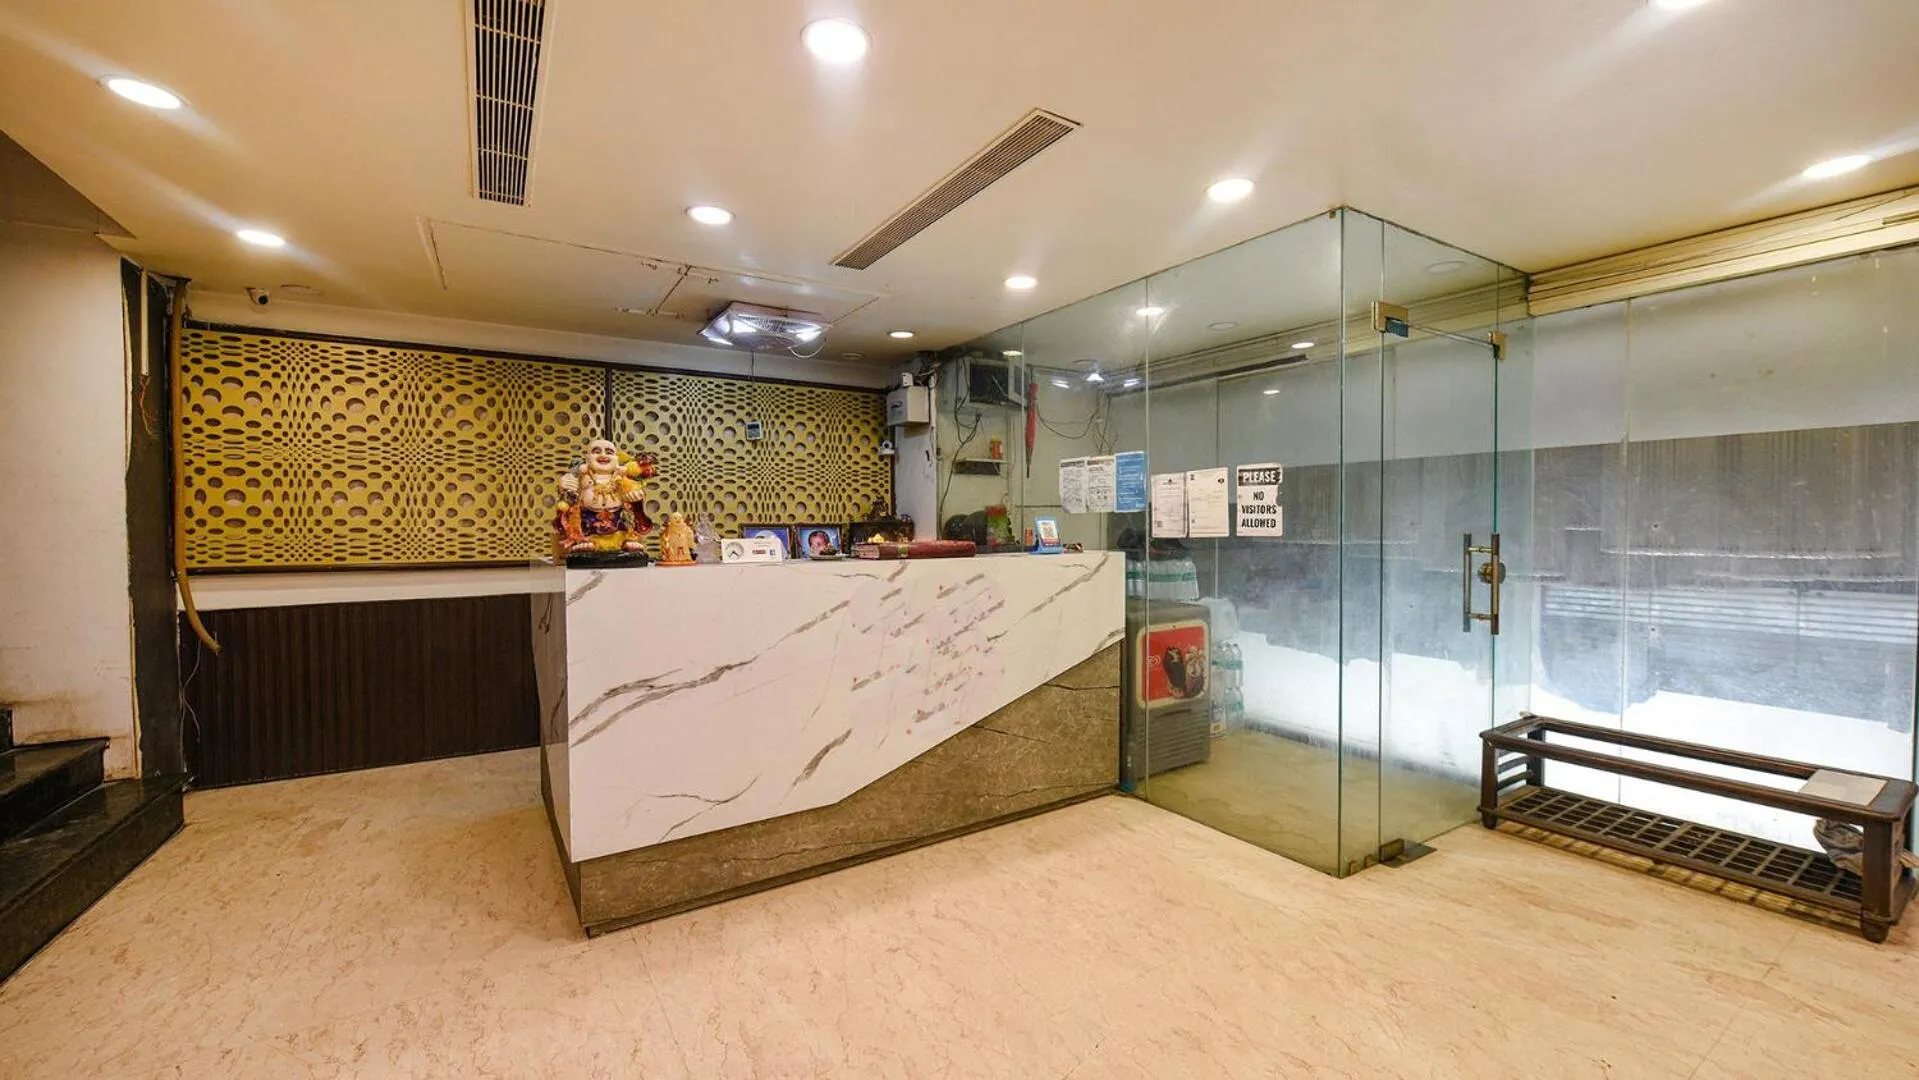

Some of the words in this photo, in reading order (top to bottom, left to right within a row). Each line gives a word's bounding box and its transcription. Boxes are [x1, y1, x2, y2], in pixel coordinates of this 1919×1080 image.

[1242, 470, 1276, 482] PLEASE
[1253, 491, 1264, 501] NO
[1241, 504, 1277, 514] VISITORS
[1241, 518, 1276, 528] ALLOWED
